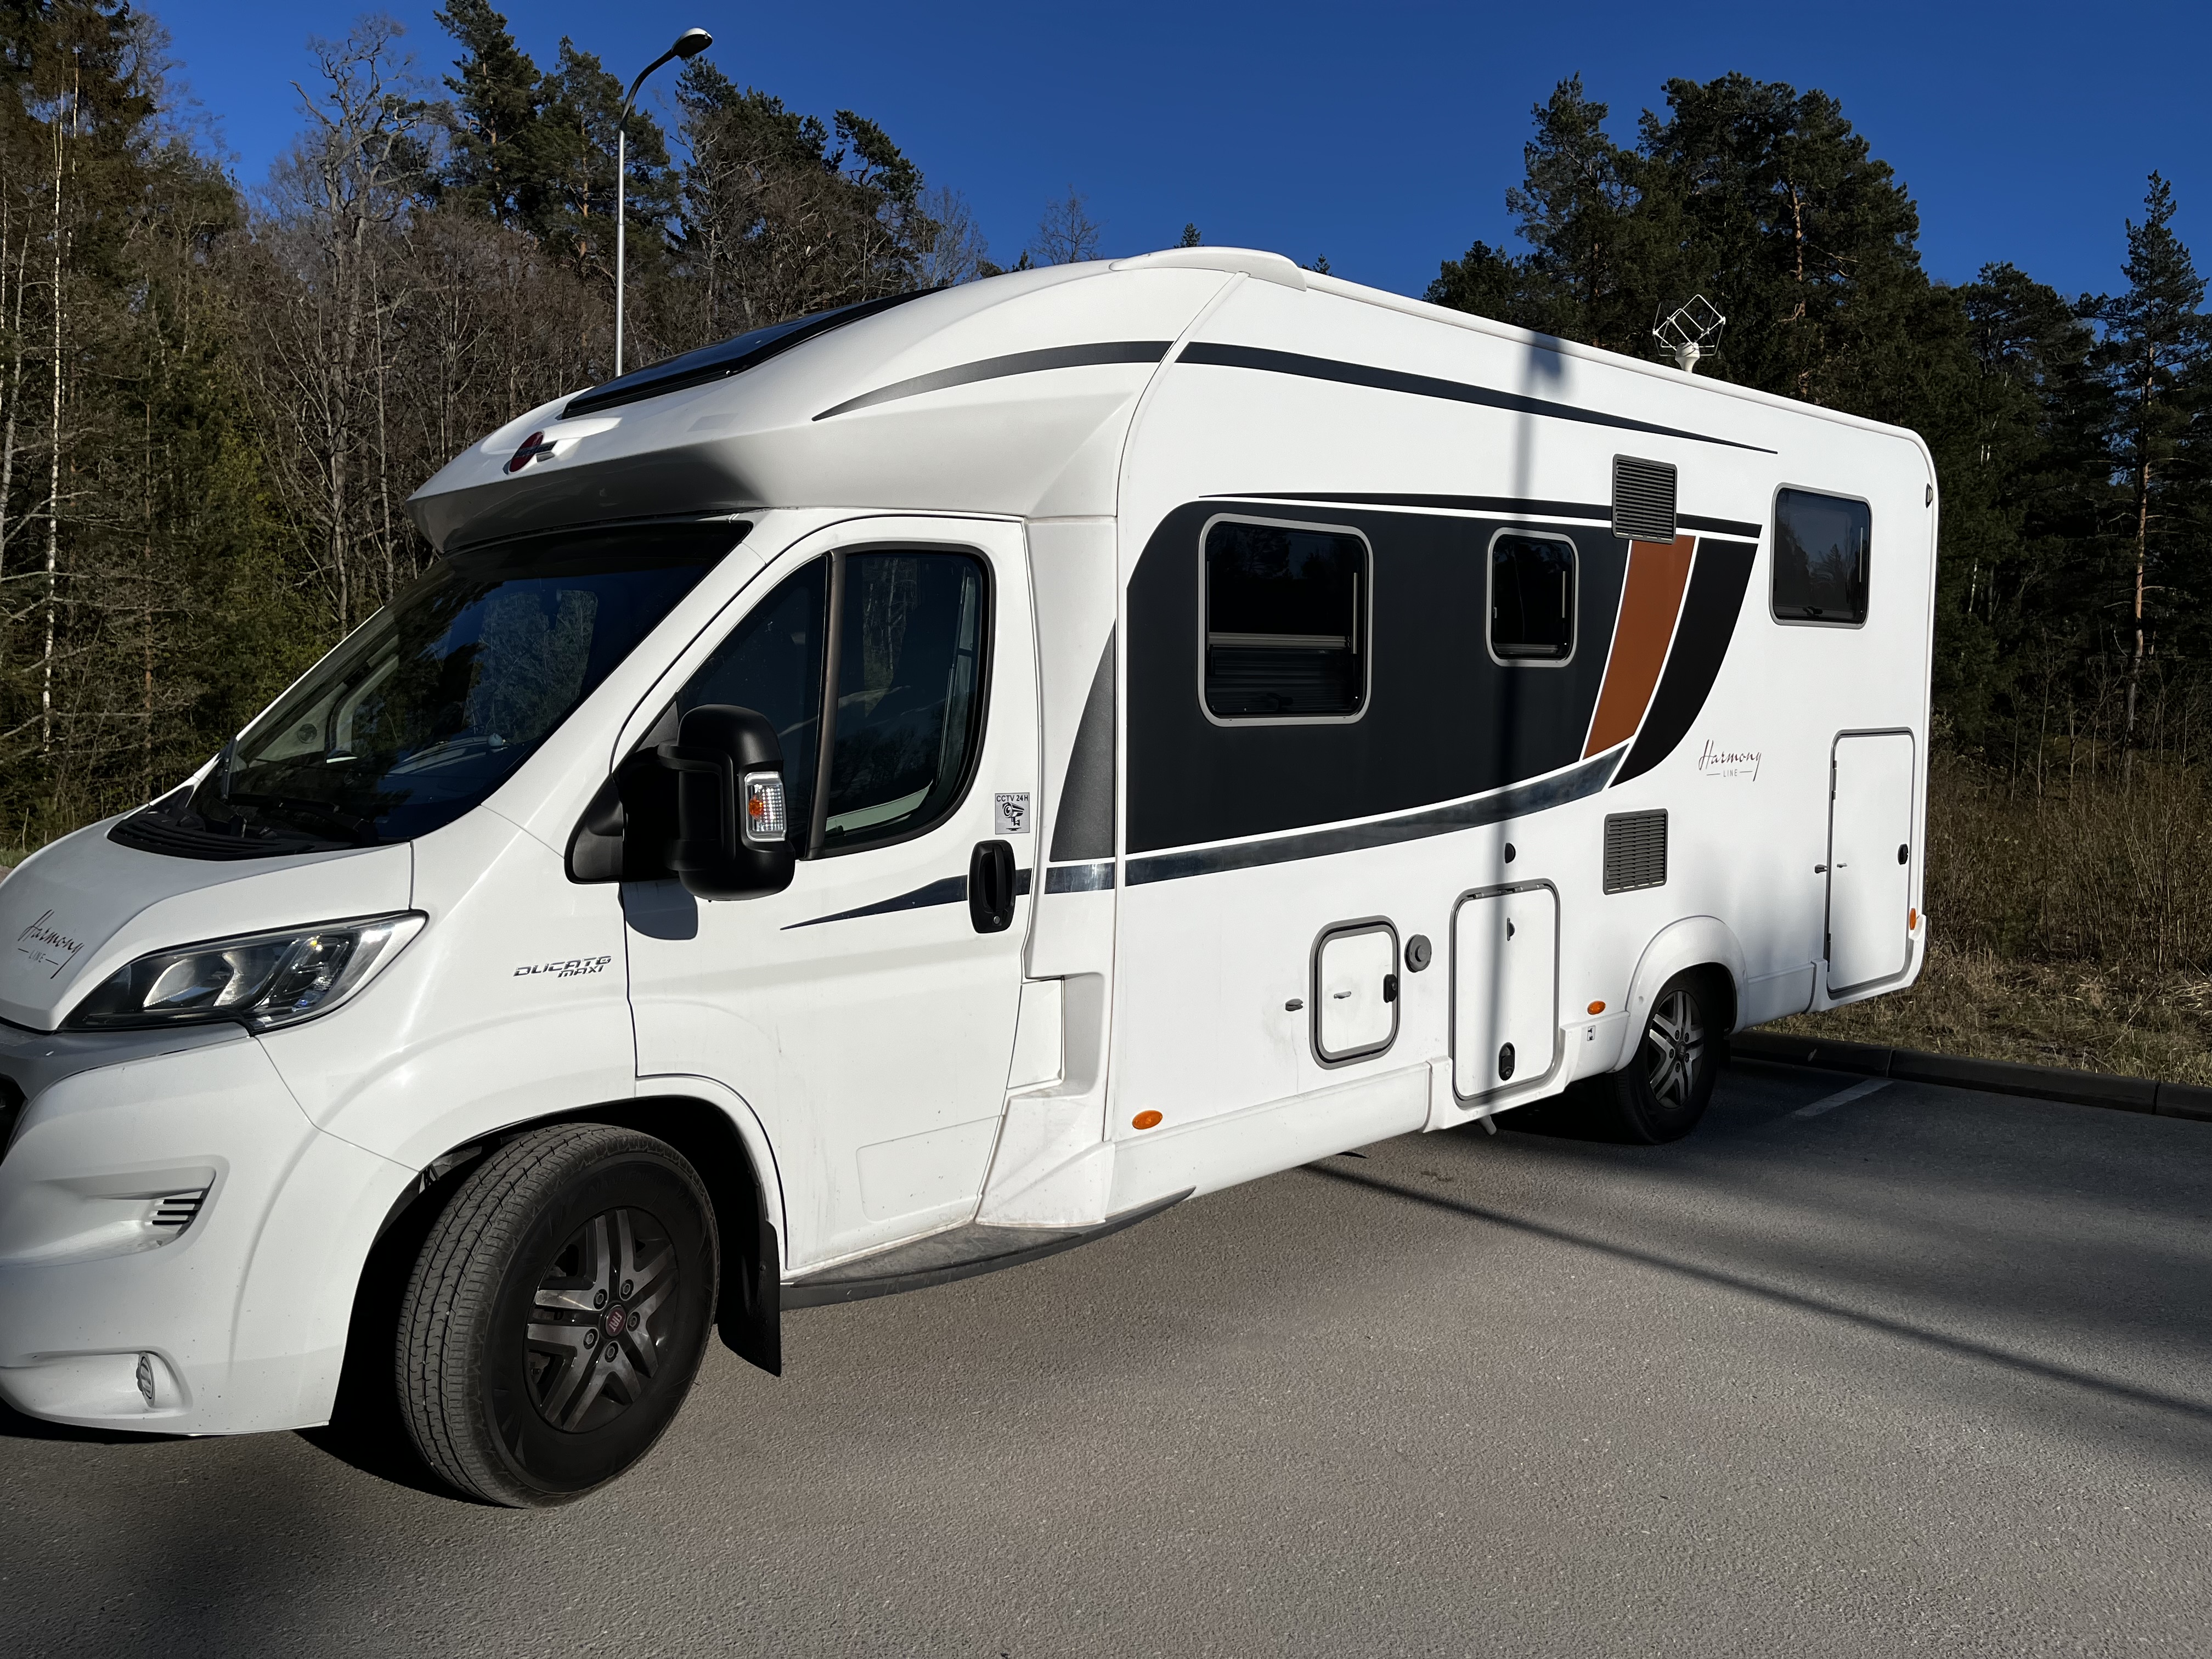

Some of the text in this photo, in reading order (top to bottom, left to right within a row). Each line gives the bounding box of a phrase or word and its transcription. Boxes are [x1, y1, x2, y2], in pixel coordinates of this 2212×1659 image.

[1699, 739, 1762, 782] Harmony
[1723, 769, 1737, 777] LINE
[18, 909, 84, 979] Harmony
[29, 950, 46, 963] LINE
[513, 955, 612, 977] DUCATO
[557, 964, 604, 978] MAXI
[608, 1311, 623, 1333] FIAT
